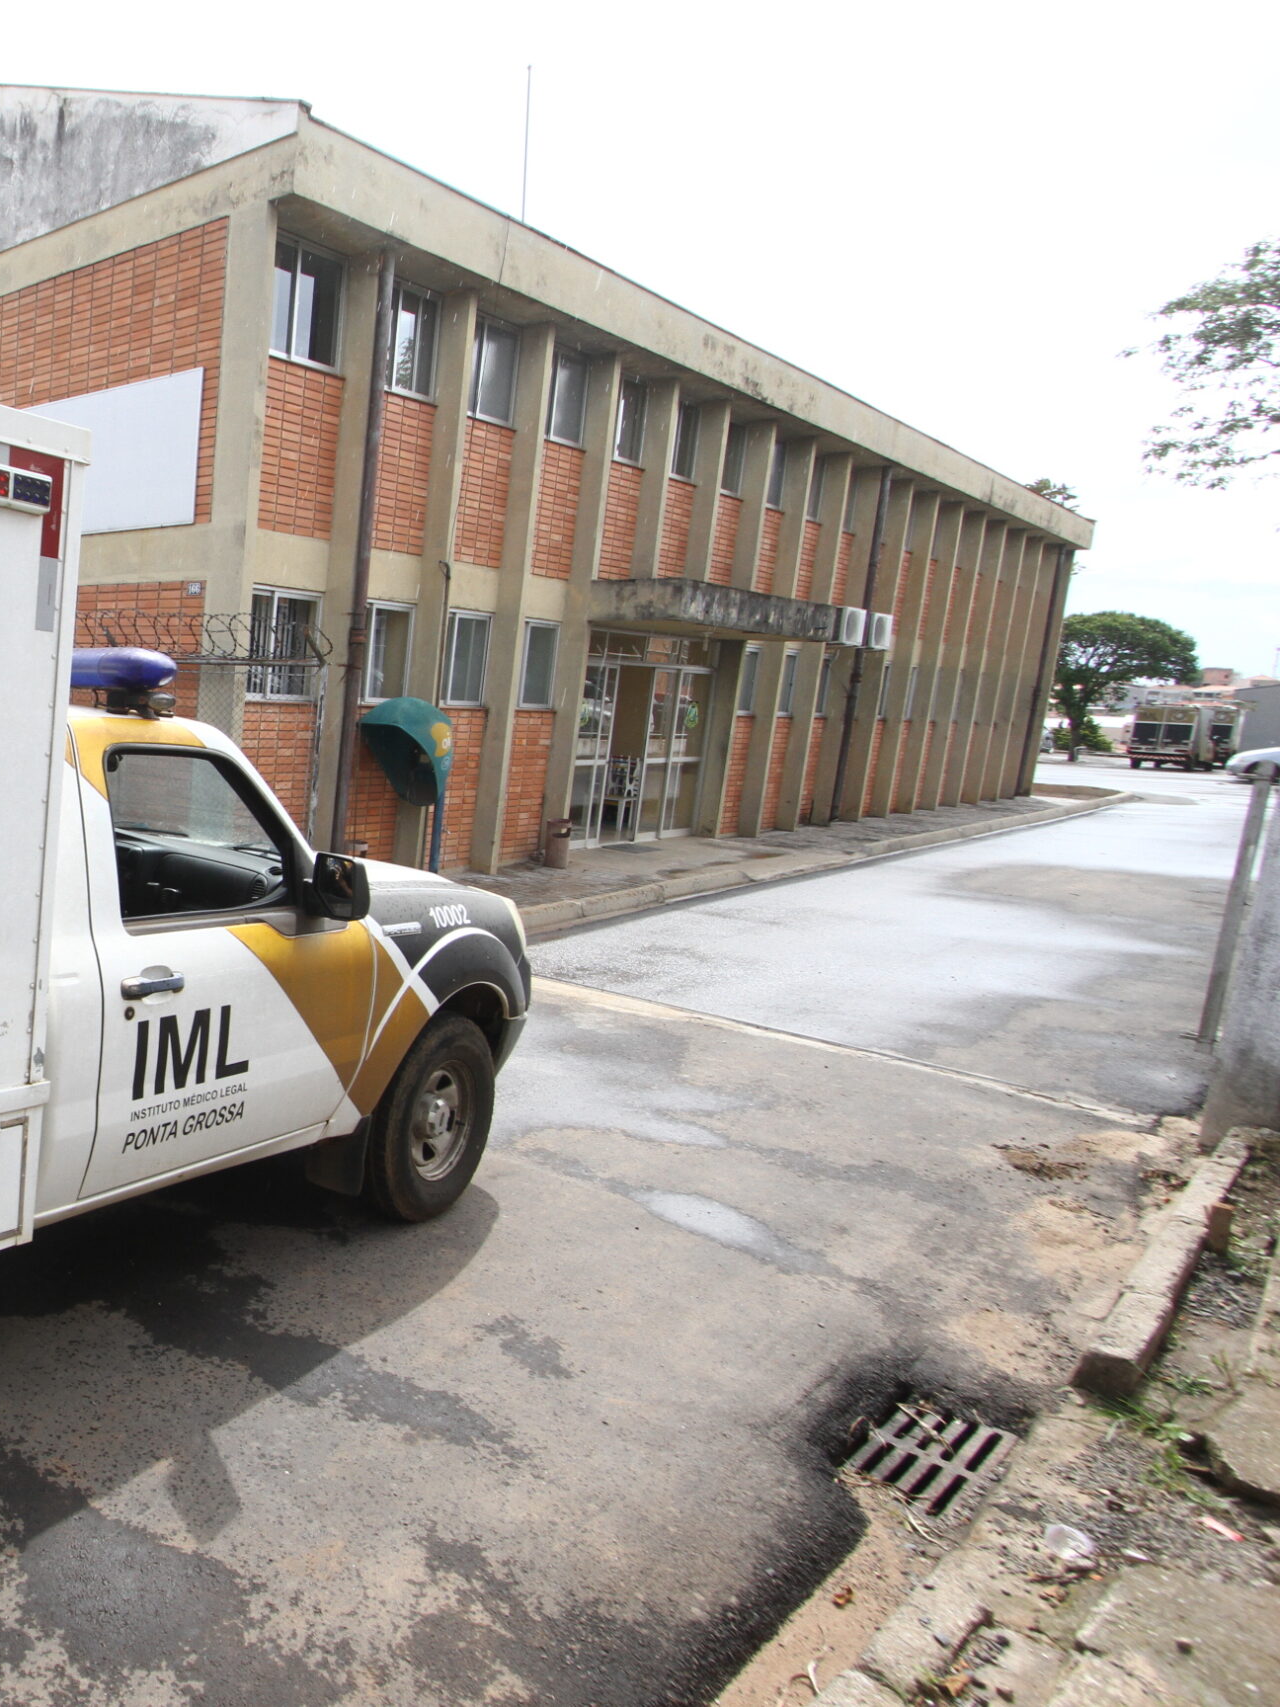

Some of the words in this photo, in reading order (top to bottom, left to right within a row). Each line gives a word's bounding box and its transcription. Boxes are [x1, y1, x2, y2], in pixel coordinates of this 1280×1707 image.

[429, 904, 471, 928] 10002
[132, 1004, 249, 1101] IML
[130, 1100, 180, 1121] INSTITUTO
[183, 1089, 218, 1108] MÉDICO
[220, 1082, 248, 1098] LEGAL
[121, 1120, 178, 1154] PONTA
[182, 1101, 245, 1136] GROSSA
